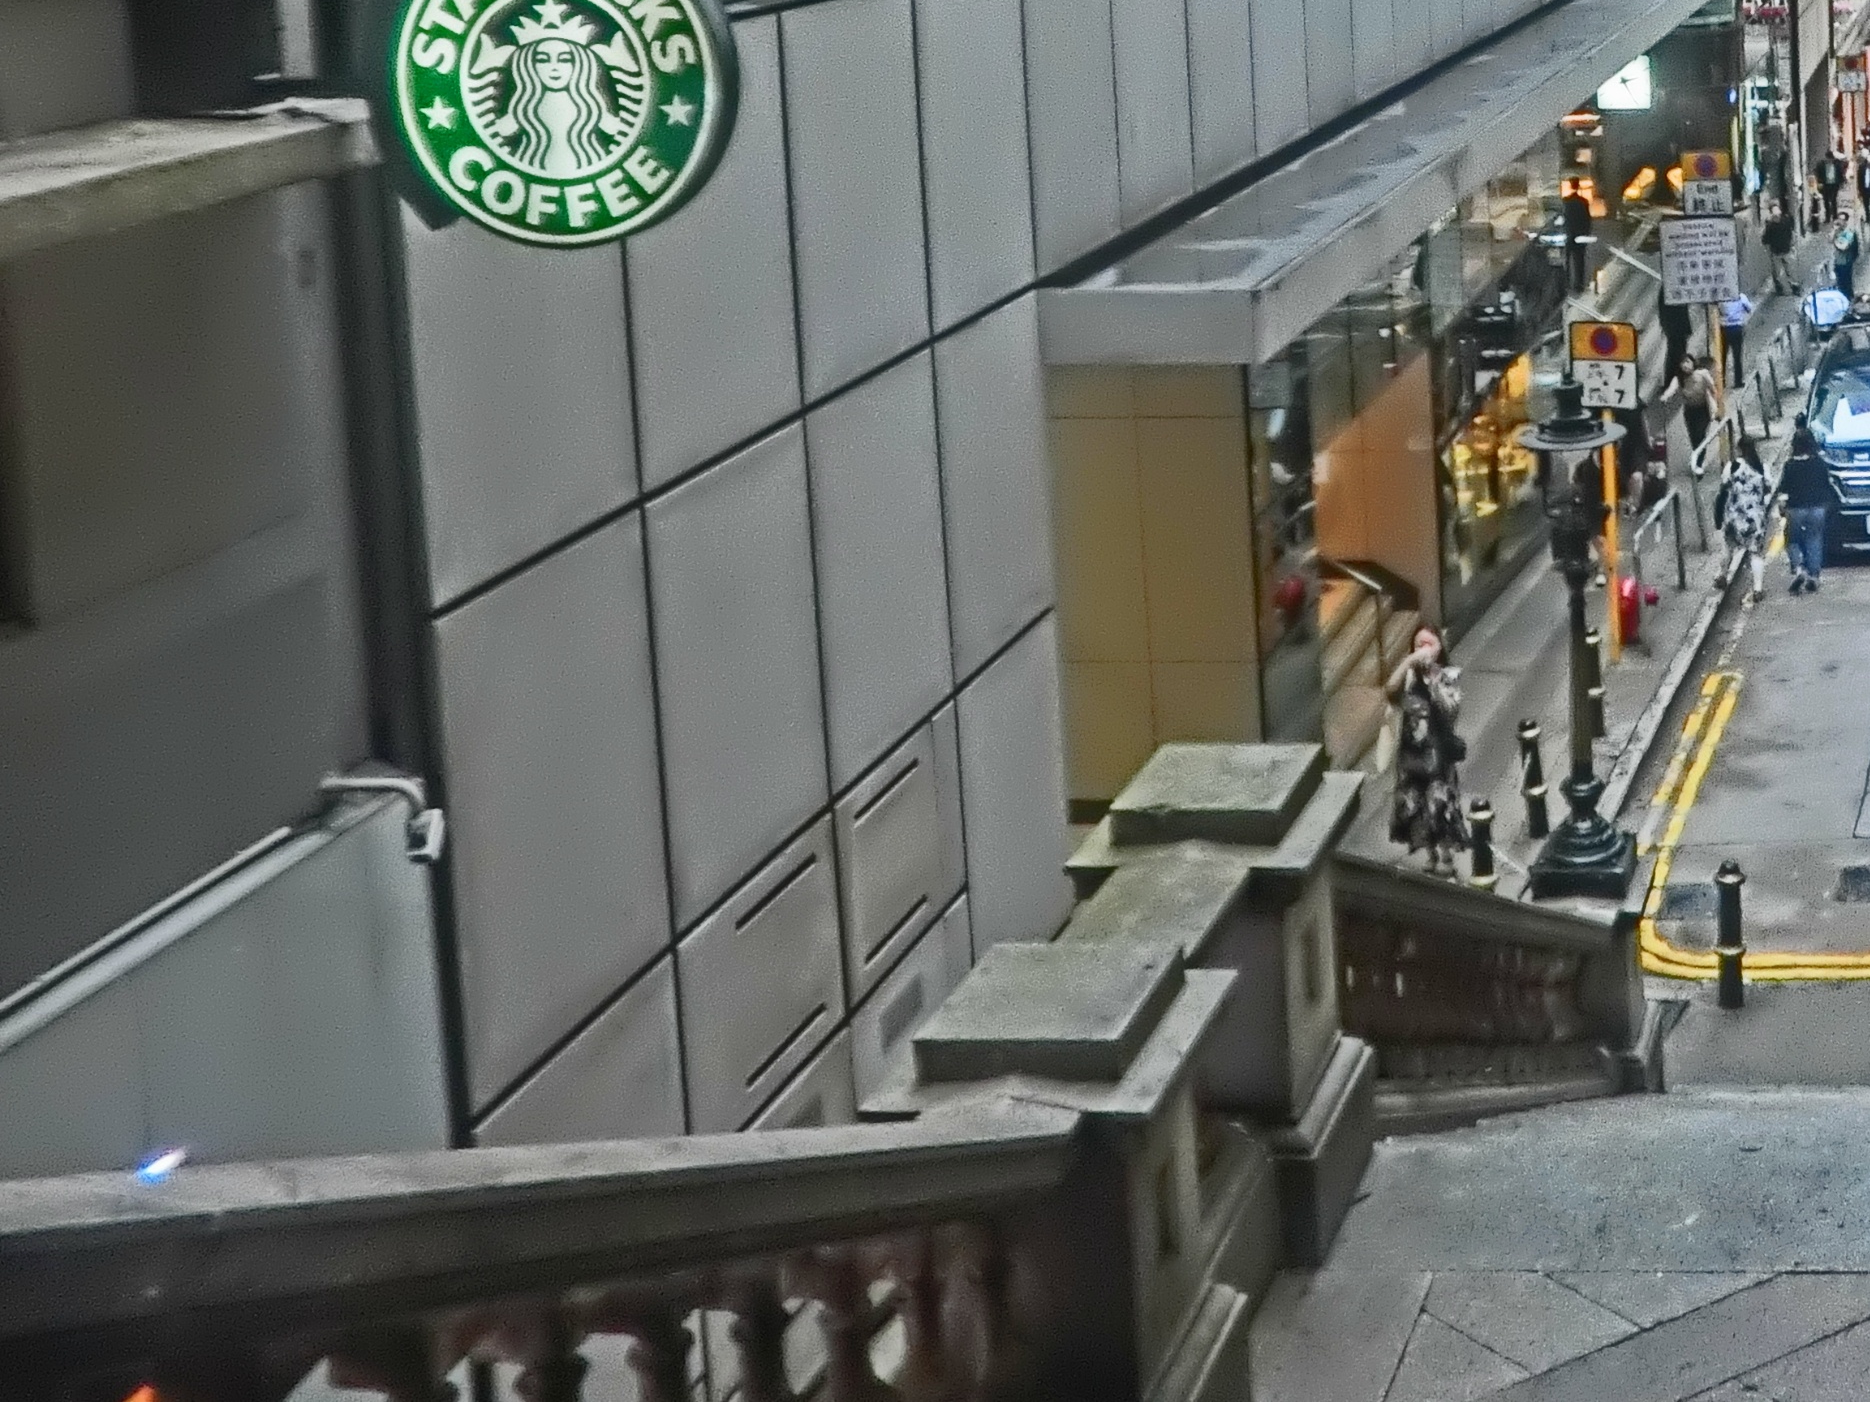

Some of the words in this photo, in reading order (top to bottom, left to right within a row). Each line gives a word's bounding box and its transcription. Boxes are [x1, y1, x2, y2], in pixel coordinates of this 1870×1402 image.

[448, 145, 673, 228] COFFEE
[1615, 364, 1625, 380] 7
[1614, 389, 1625, 404] 7
